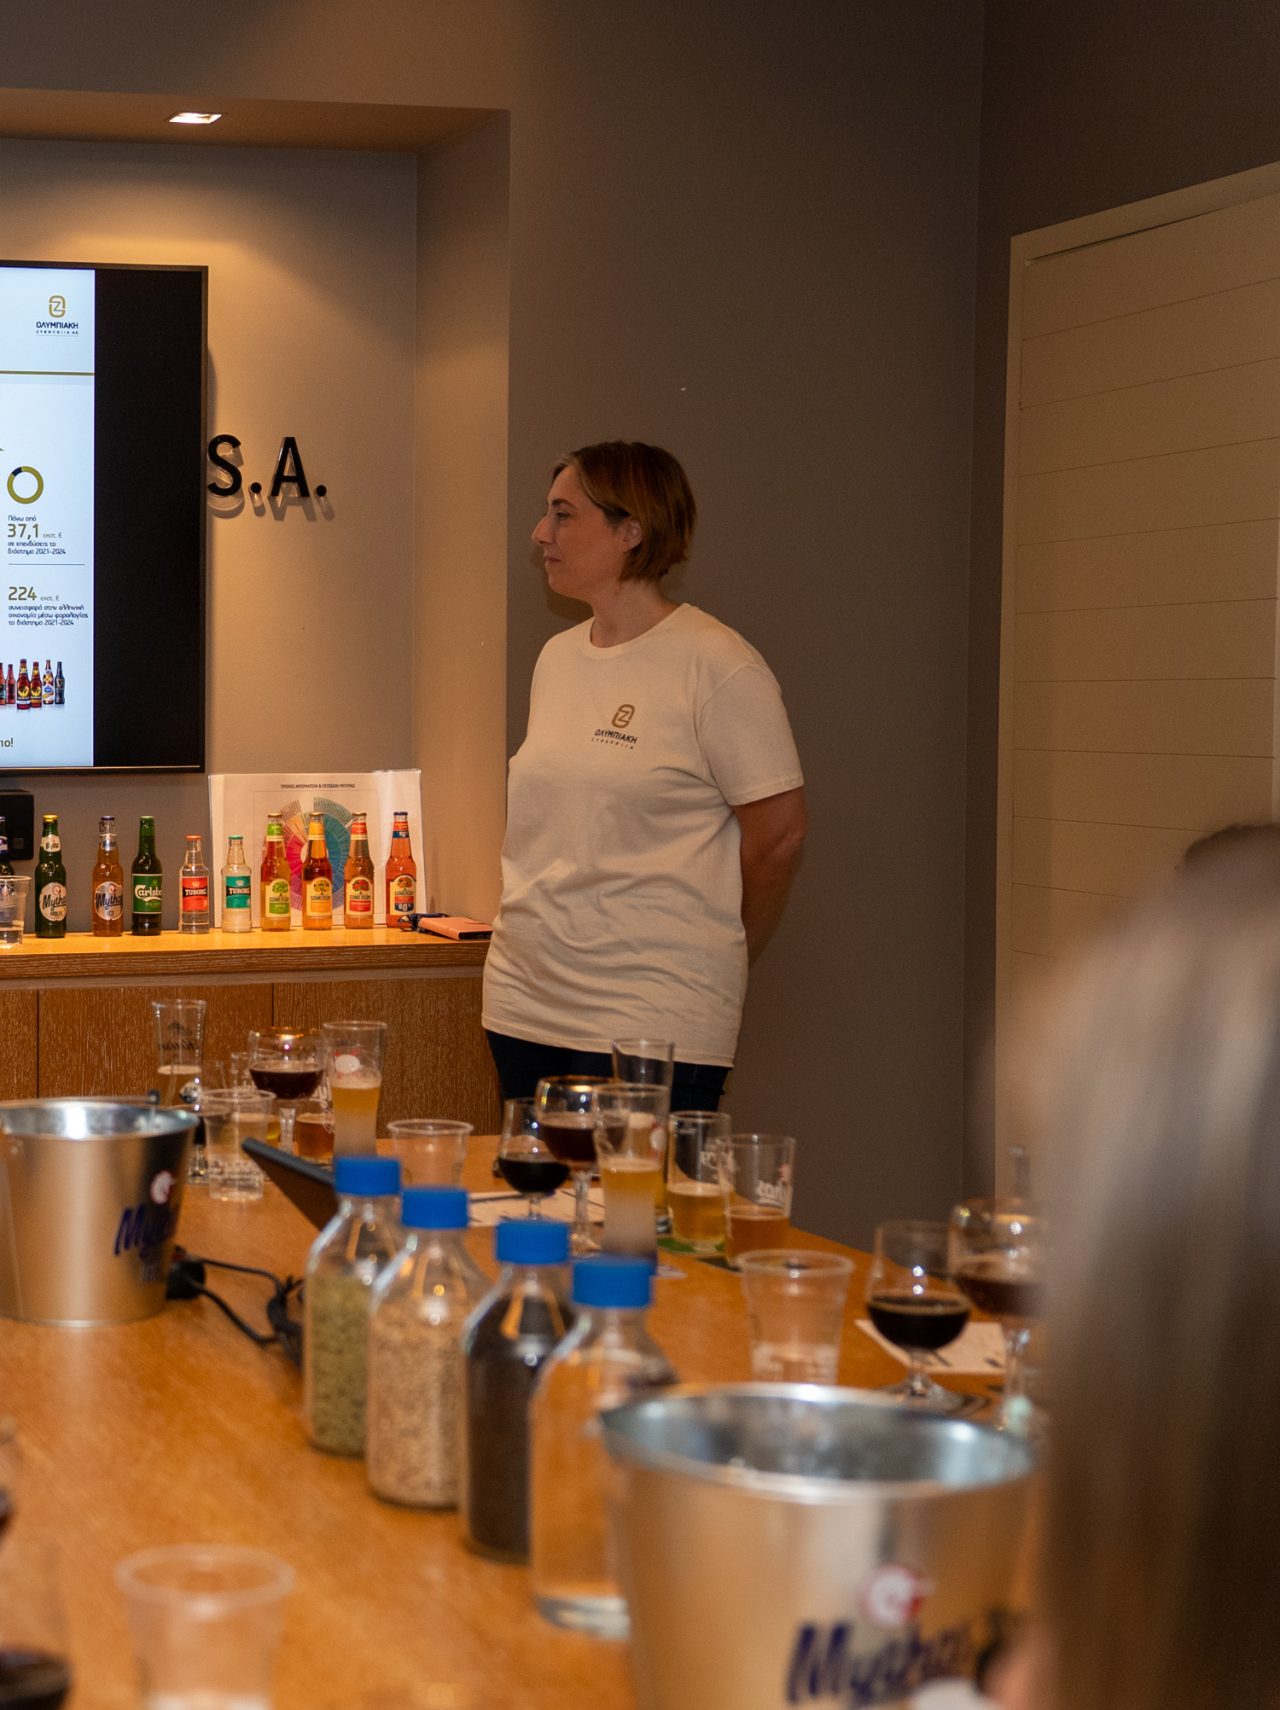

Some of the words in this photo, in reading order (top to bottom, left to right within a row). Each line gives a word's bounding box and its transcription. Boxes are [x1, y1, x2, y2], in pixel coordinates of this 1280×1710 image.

[36, 321, 78, 329] ΟΛΥΜΠΙΑΚΗ
[208, 434, 327, 497] S.A.
[7, 524, 39, 540] 37,1
[8, 586, 37, 601] 224
[594, 729, 638, 744] ΟΛΥΜΠΙΑΚΗ
